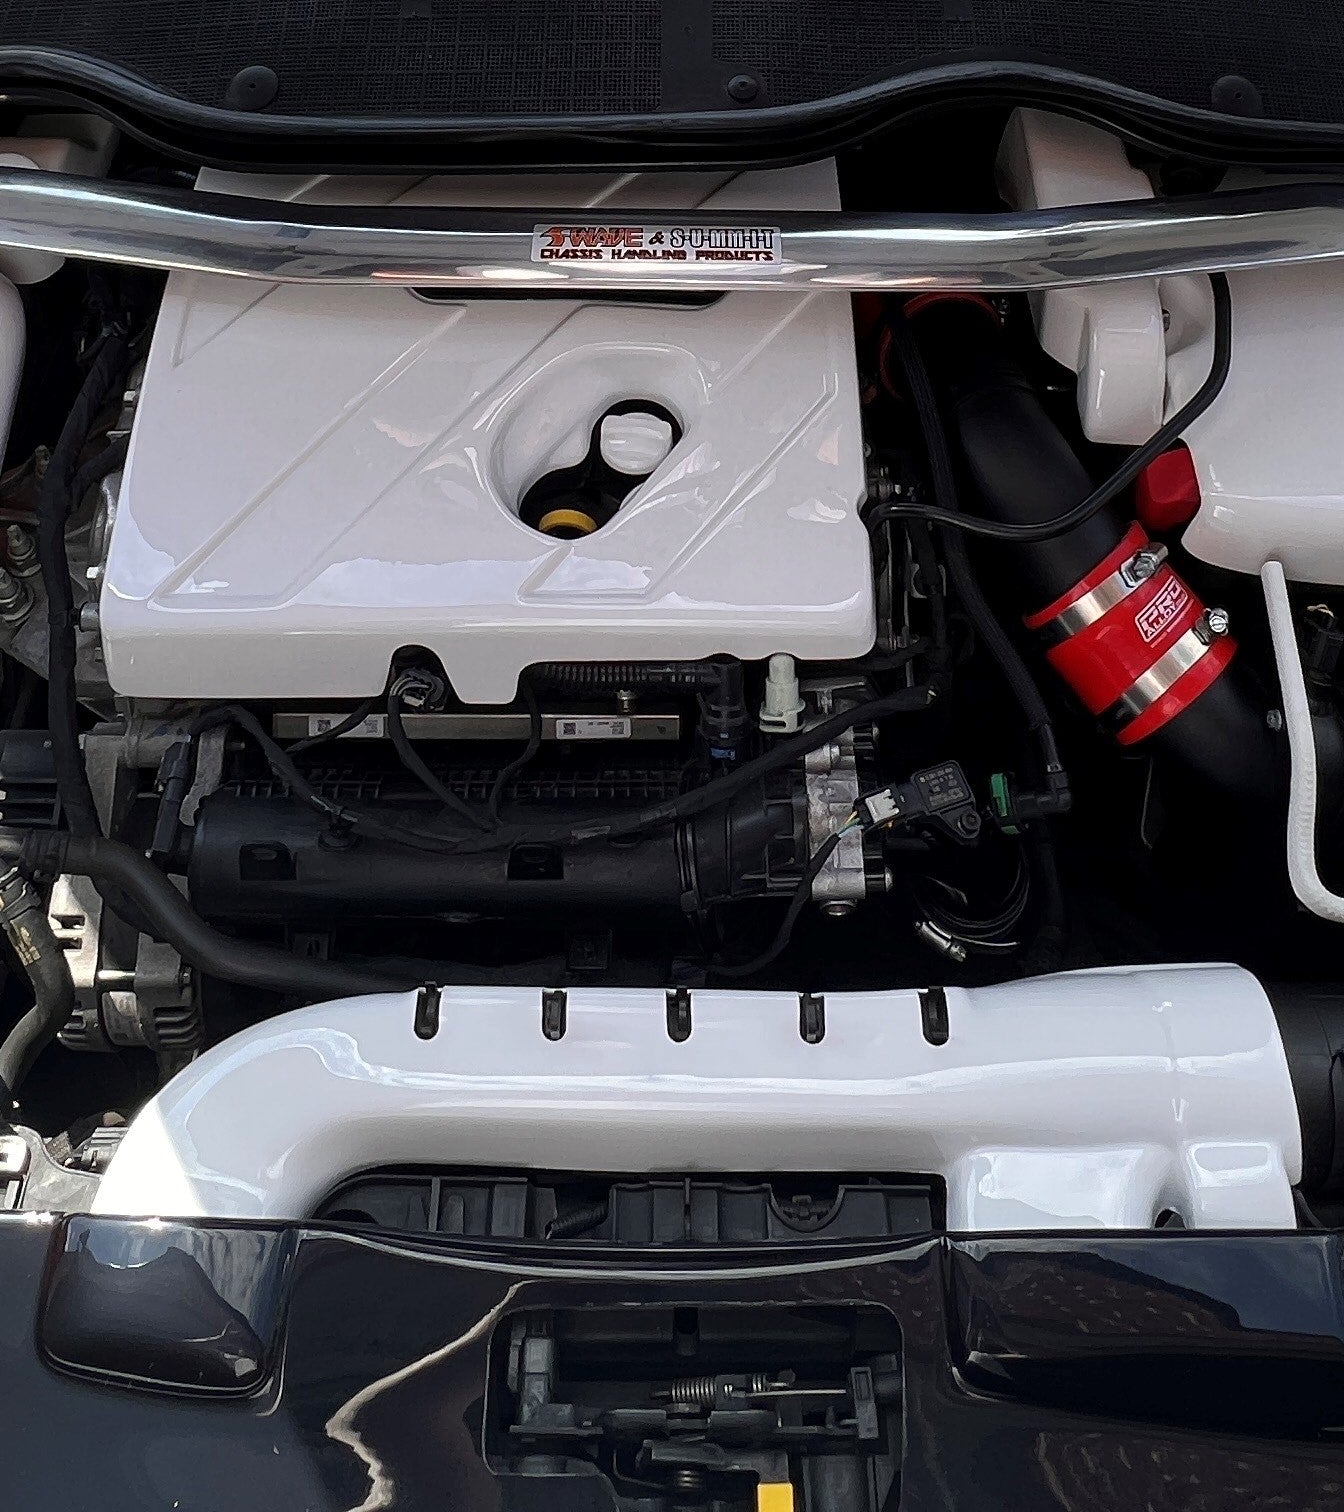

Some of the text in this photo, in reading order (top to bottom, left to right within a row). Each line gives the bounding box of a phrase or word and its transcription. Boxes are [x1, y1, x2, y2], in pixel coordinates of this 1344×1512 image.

[647, 230, 664, 246] &
[540, 248, 603, 261] CHASSIS
[695, 249, 774, 262] PRODUCTS
